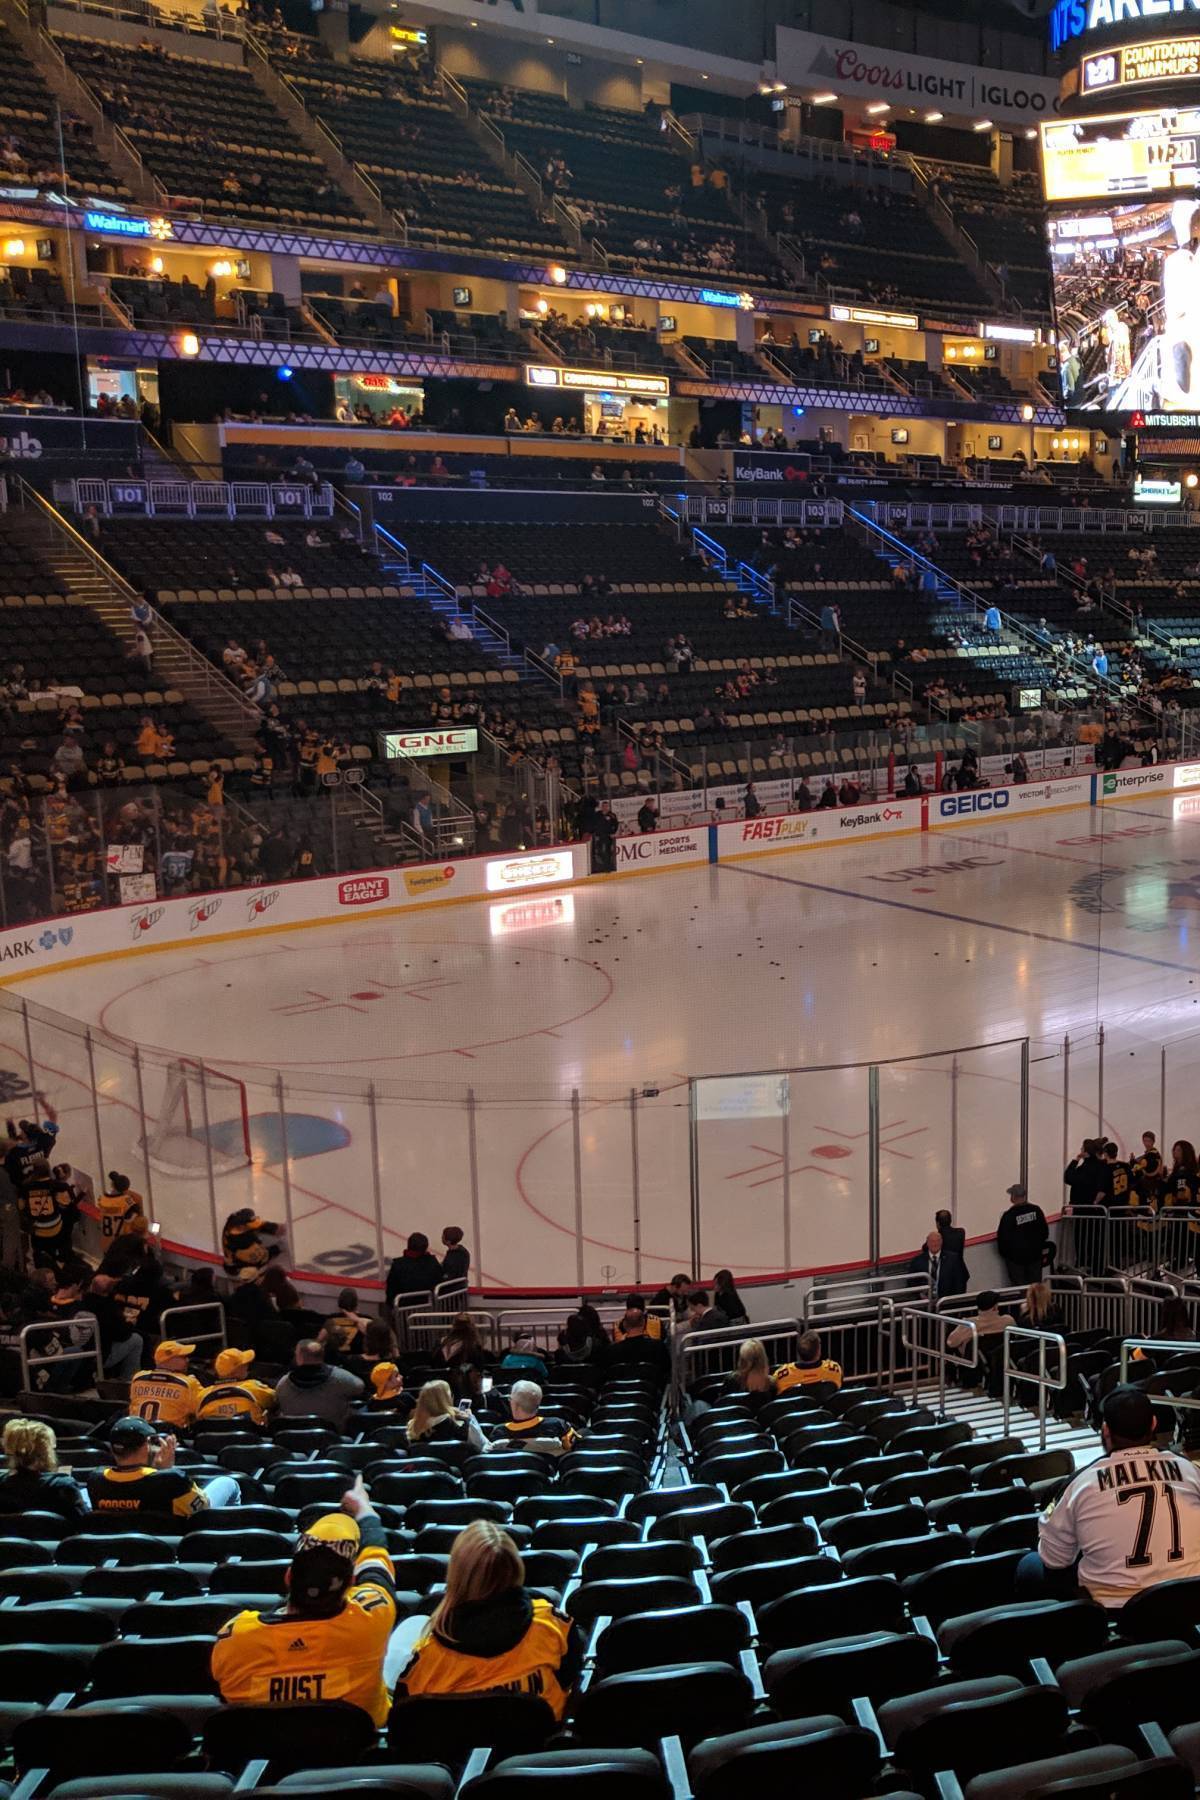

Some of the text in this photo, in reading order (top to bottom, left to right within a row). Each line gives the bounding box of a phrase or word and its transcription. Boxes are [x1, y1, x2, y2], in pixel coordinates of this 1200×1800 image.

[1125, 42, 1200, 66] COUNTDOWN
[1126, 57, 1199, 80] TO WARMUPS
[836, 49, 905, 89] Coors
[907, 75, 966, 100] LIGHT
[982, 84, 1046, 112] IGLOO
[88, 213, 151, 235] Walmart
[1145, 415, 1198, 427] MITSUBISHI
[736, 467, 784, 481] KeyBank
[116, 488, 142, 502] 101
[279, 491, 301, 505] 101
[378, 492, 393, 501] 102
[708, 503, 727, 514] 103
[807, 505, 825, 516] 103
[892, 508, 907, 518] 104
[1129, 515, 1144, 524] 104
[399, 733, 466, 748] GNC
[1104, 771, 1165, 790] enterprise
[1019, 784, 1082, 799] VECTOR SECURITY
[940, 789, 1010, 817] GEICO
[840, 813, 882, 828] KeyBank
[659, 835, 691, 847] SPORTS
[614, 841, 652, 862] PMC
[659, 843, 698, 856] MEDICINE
[860, 855, 1006, 883] UPMC
[343, 880, 385, 893] GIANT
[344, 889, 385, 902] EAGLE
[1016, 1211, 1037, 1225] SECURITY
[102, 1216, 124, 1237] 87
[1097, 1460, 1184, 1492] MALKIN
[1115, 1482, 1184, 1568] 71
[269, 1674, 326, 1700] RUST
